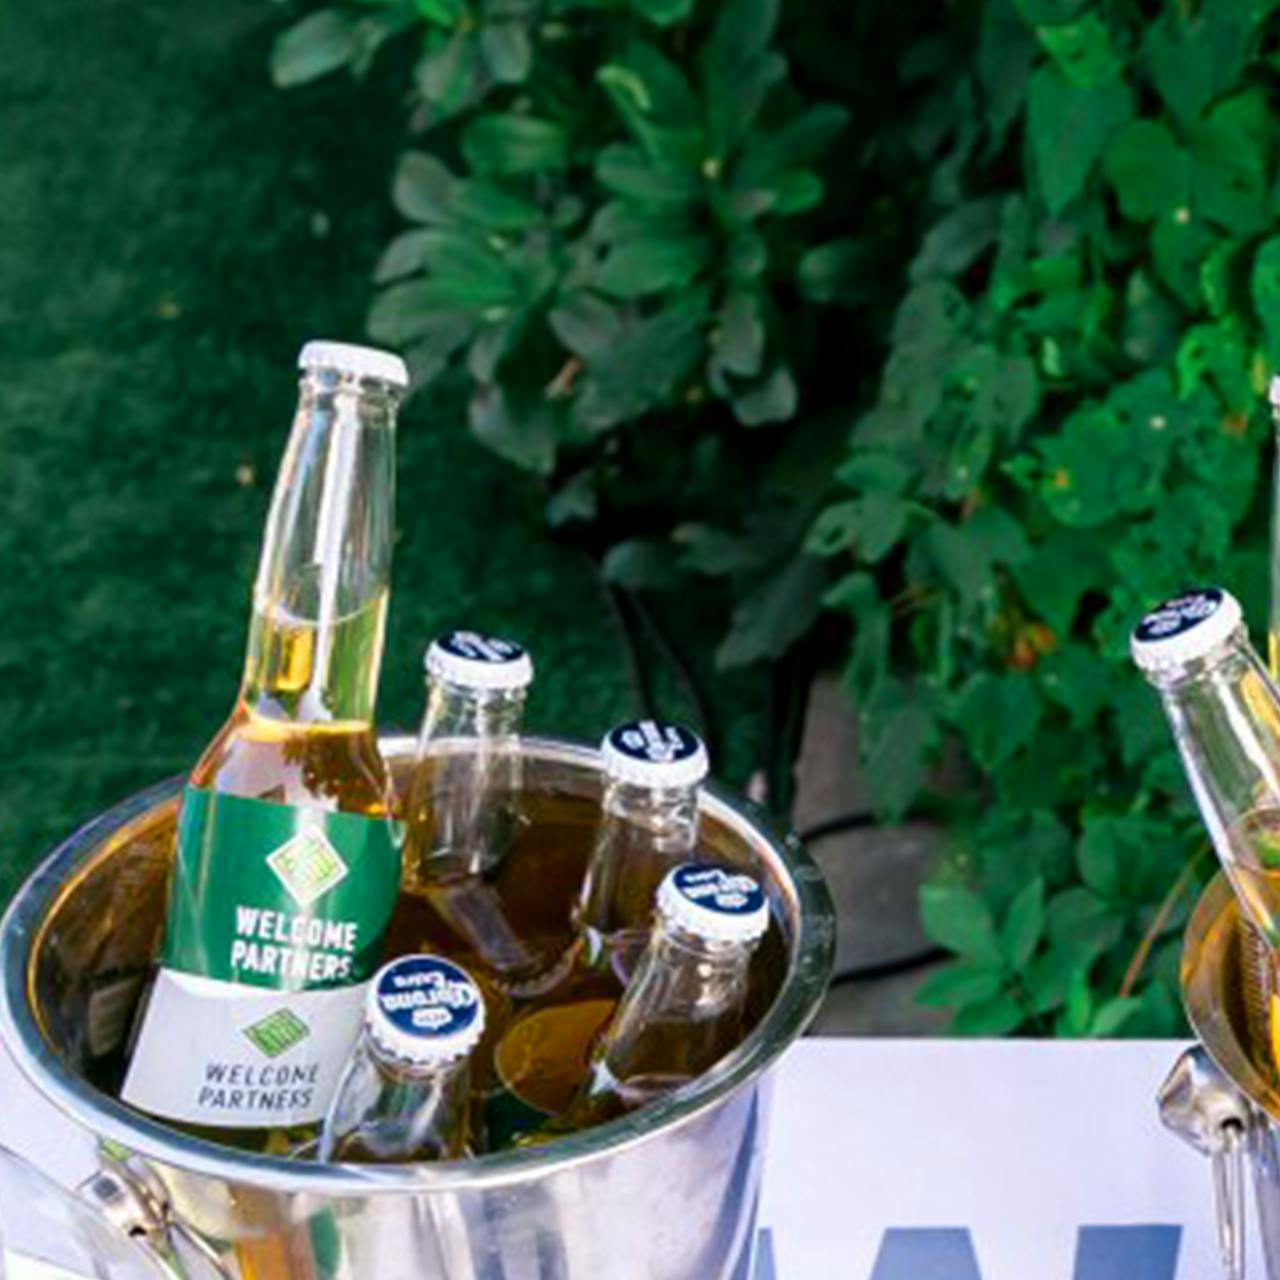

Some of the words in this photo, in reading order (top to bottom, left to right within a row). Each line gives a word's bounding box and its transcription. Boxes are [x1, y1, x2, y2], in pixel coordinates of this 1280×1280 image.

[236, 905, 358, 951] WELCOME
[230, 940, 353, 981] PARTNERS
[381, 981, 474, 1012] Corona
[204, 1063, 319, 1085] WELCOME
[200, 1087, 315, 1111] PARTNERS
